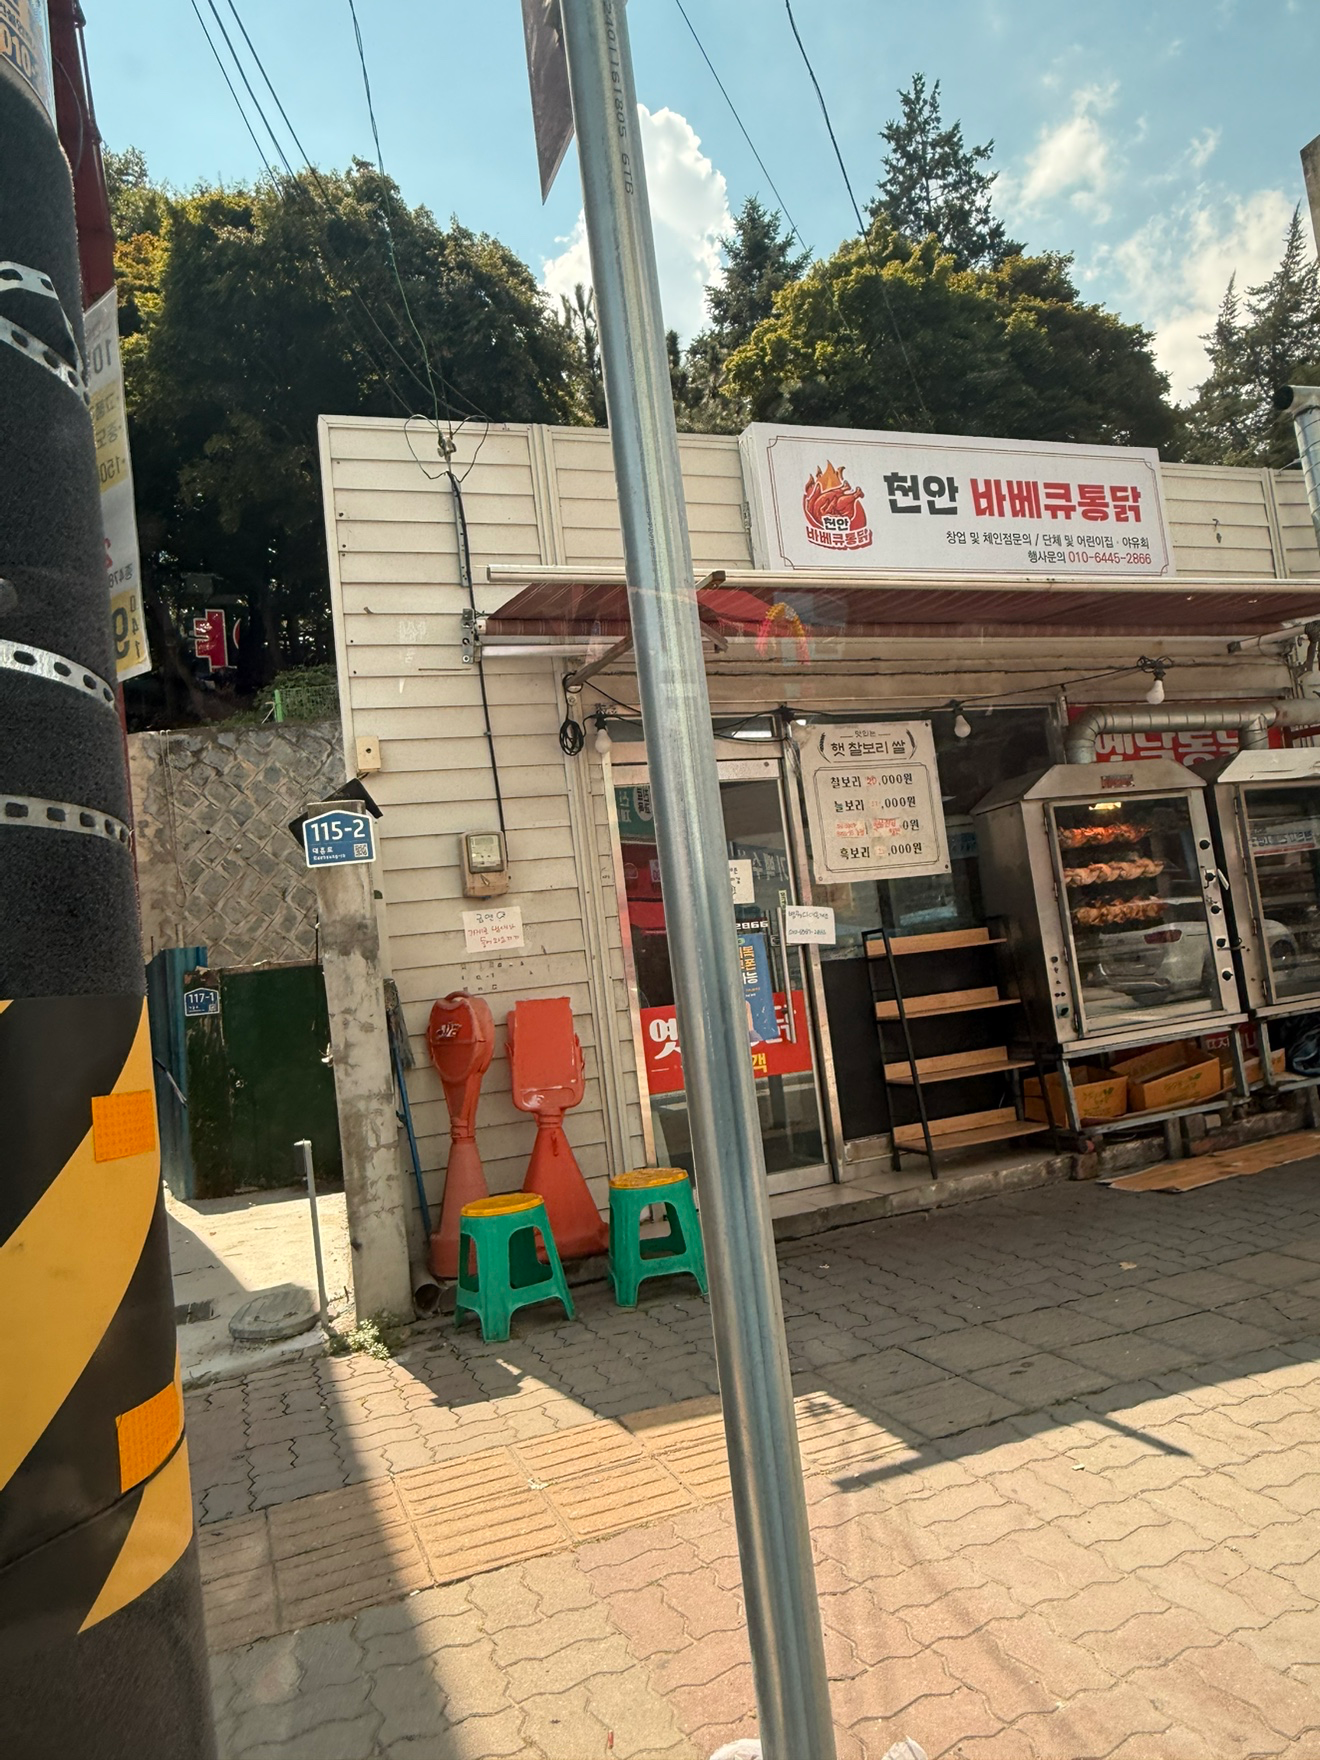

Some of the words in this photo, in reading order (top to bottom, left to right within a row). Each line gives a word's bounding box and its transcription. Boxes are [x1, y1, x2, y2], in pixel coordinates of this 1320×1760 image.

[883, 472, 959, 516] 천안
[969, 478, 1142, 523] 바베큐통닭
[823, 517, 850, 532] 천안
[805, 526, 869, 546] 바베큐통닭
[946, 531, 967, 545] 창업
[969, 531, 980, 545] 및
[982, 532, 1032, 546] 체인점문의
[1042, 534, 1063, 547] 단체
[1064, 535, 1074, 548] 및
[1077, 535, 1114, 549] 어린이집
[1122, 536, 1150, 549] 야유회
[1027, 550, 1066, 563] 행사문의
[1068, 551, 1152, 565] 010-6445-2866
[831, 742, 846, 757] 햇
[848, 741, 889, 757] 찰보리
[891, 740, 906, 755] 쌀
[830, 776, 862, 789] 찰보리
[834, 799, 865, 813] 늘보리
[310, 819, 366, 842] 115-2
[840, 846, 871, 860] 흑보리
[188, 992, 215, 1004] 117-1
